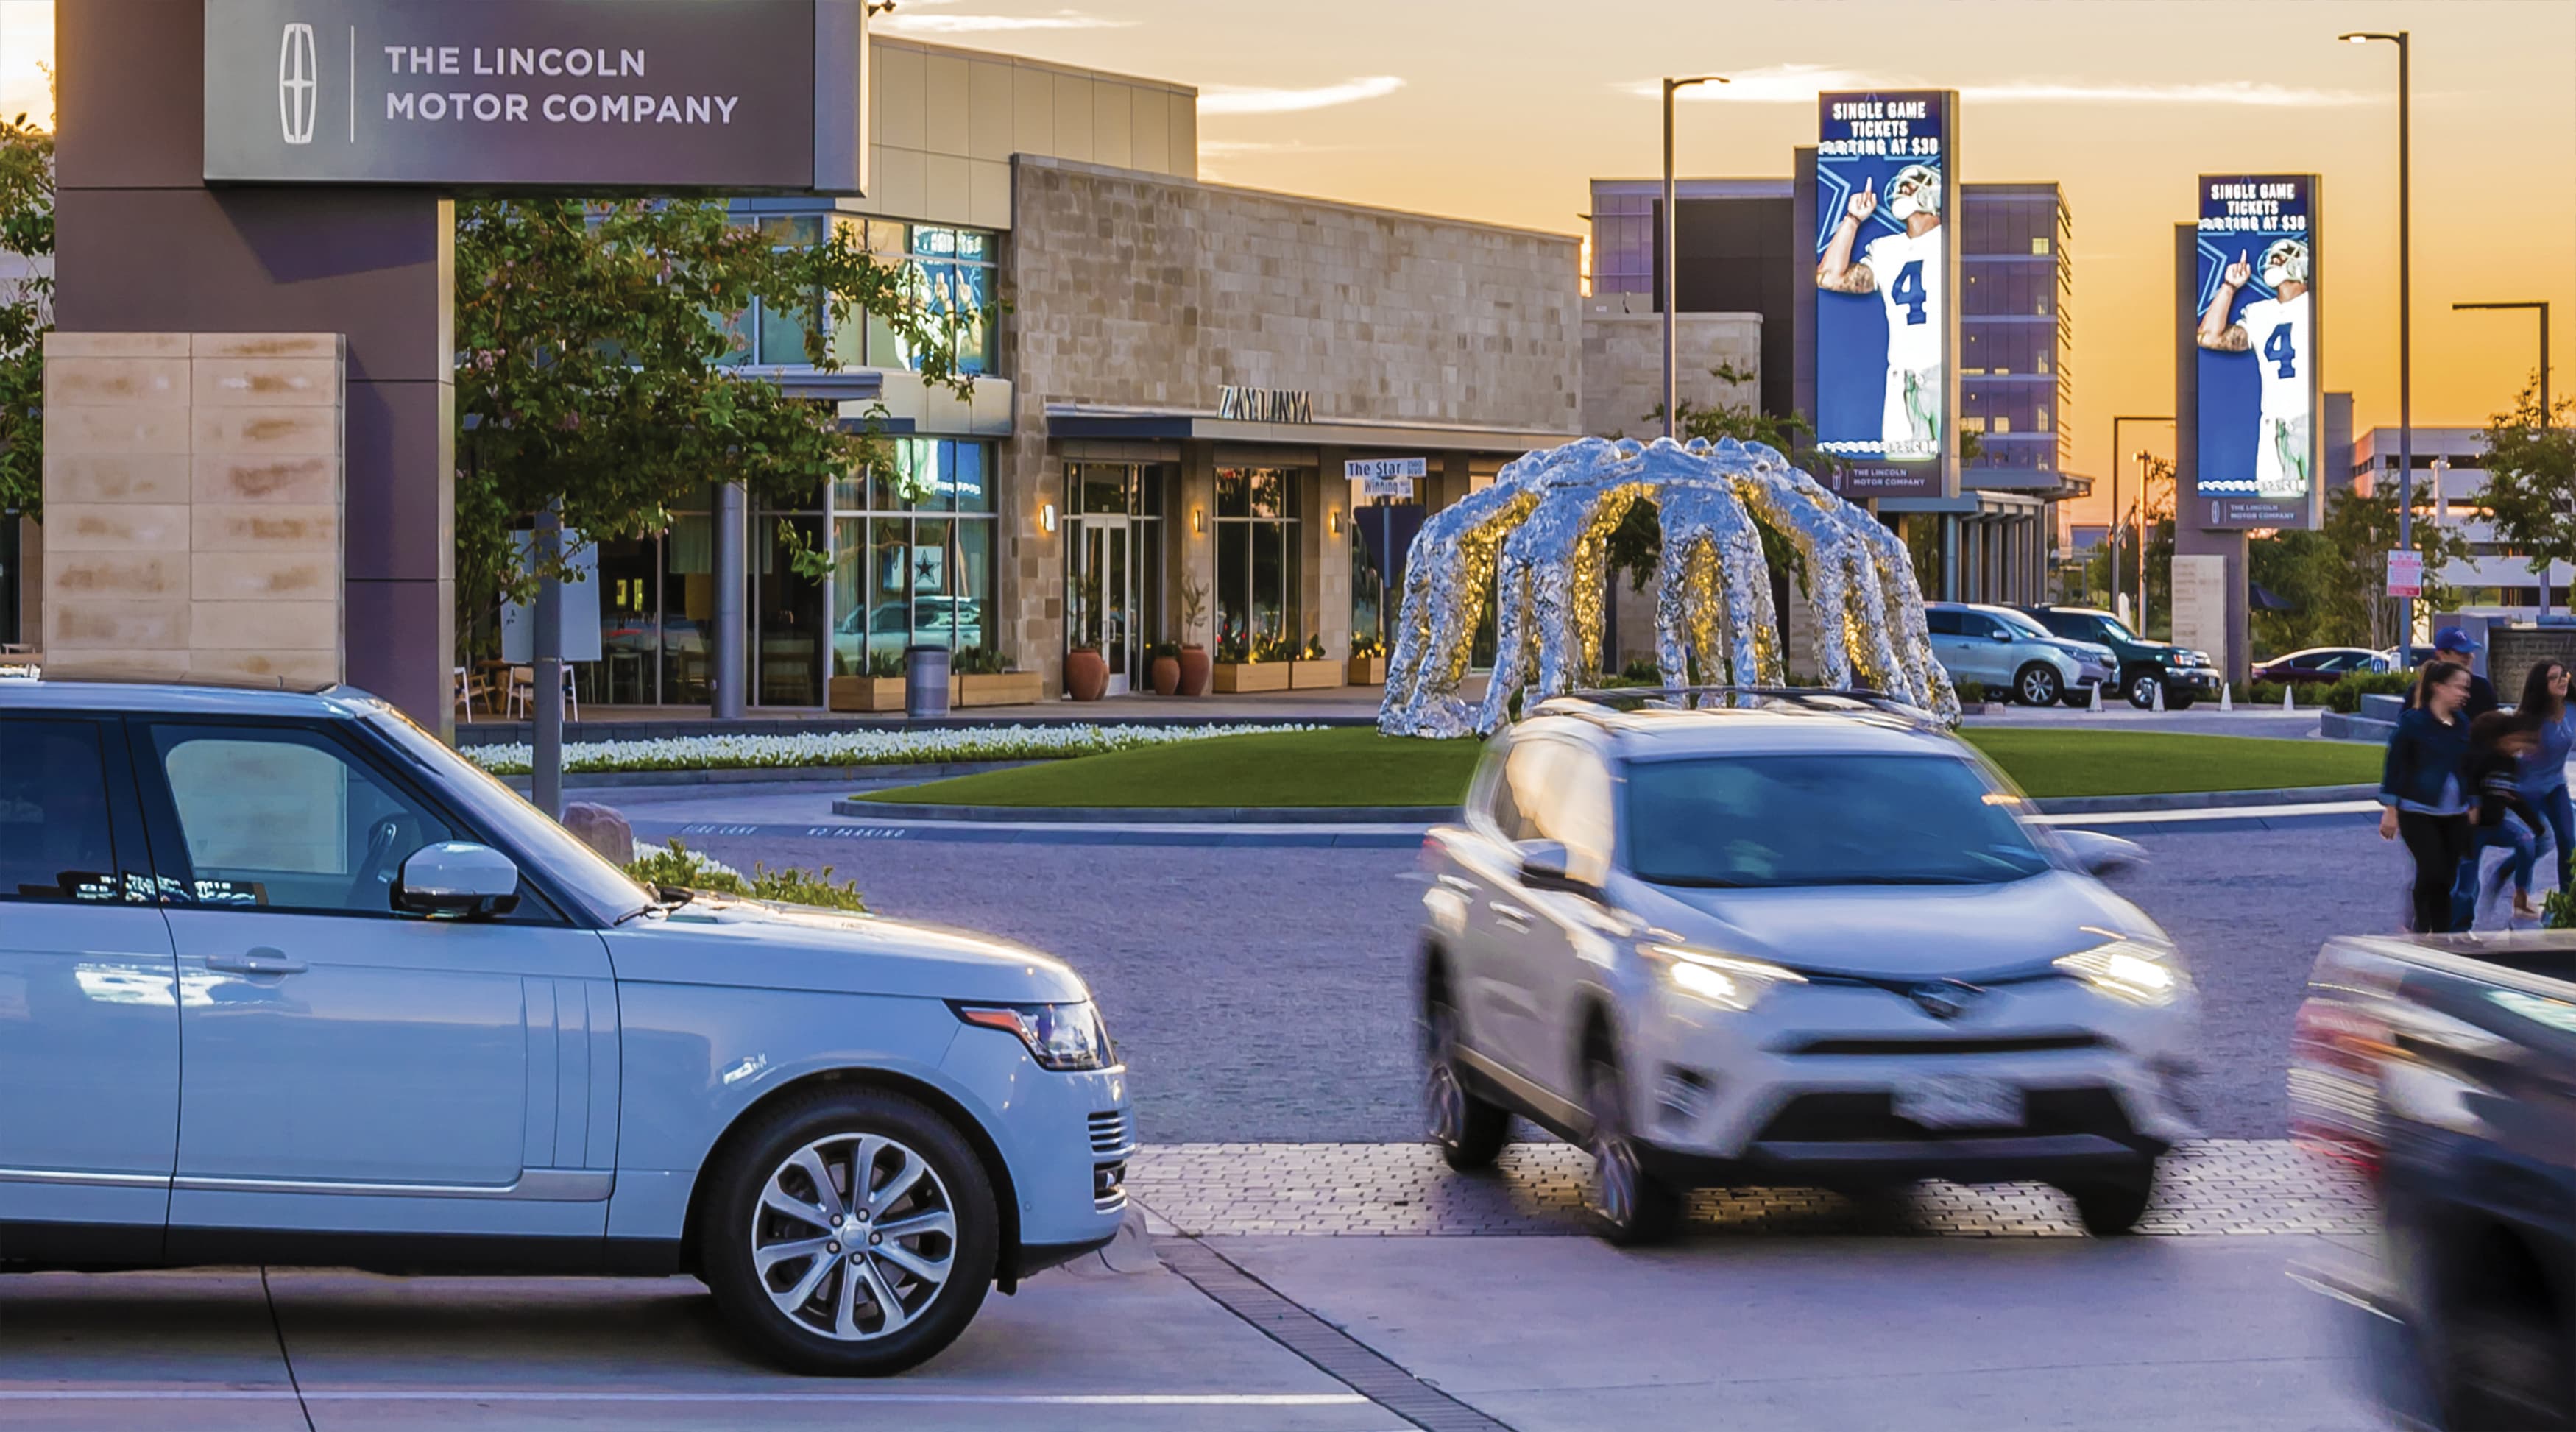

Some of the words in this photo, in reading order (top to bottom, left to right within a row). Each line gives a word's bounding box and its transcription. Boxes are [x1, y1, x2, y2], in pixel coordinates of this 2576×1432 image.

[385, 46, 459, 75] THE
[475, 48, 645, 77] LINCOLN
[386, 93, 528, 122] MOTOR
[543, 95, 738, 124] COMPANY
[1833, 102, 1883, 119] SINGLE
[1887, 102, 1926, 118] GAME
[1850, 121, 1908, 138] TICKETS
[1891, 138, 1908, 155] AT
[1911, 137, 1938, 156] $30
[2211, 184, 2256, 200] SINGLE
[2260, 184, 2295, 200] GAME
[2227, 200, 2279, 215] TICKETS
[2262, 216, 2278, 230] AT
[2282, 215, 2305, 231] $30
[1891, 259, 1926, 325] 4
[2264, 322, 2295, 379] 4
[1348, 462, 1370, 476] The
[1376, 461, 1401, 475] Star
[1853, 469, 1869, 477] THE
[1871, 469, 1907, 477] LINCOLN
[1365, 479, 1398, 494] Winning
[1853, 478, 1883, 486] MOTOR
[833, 828, 905, 837] PARKING
